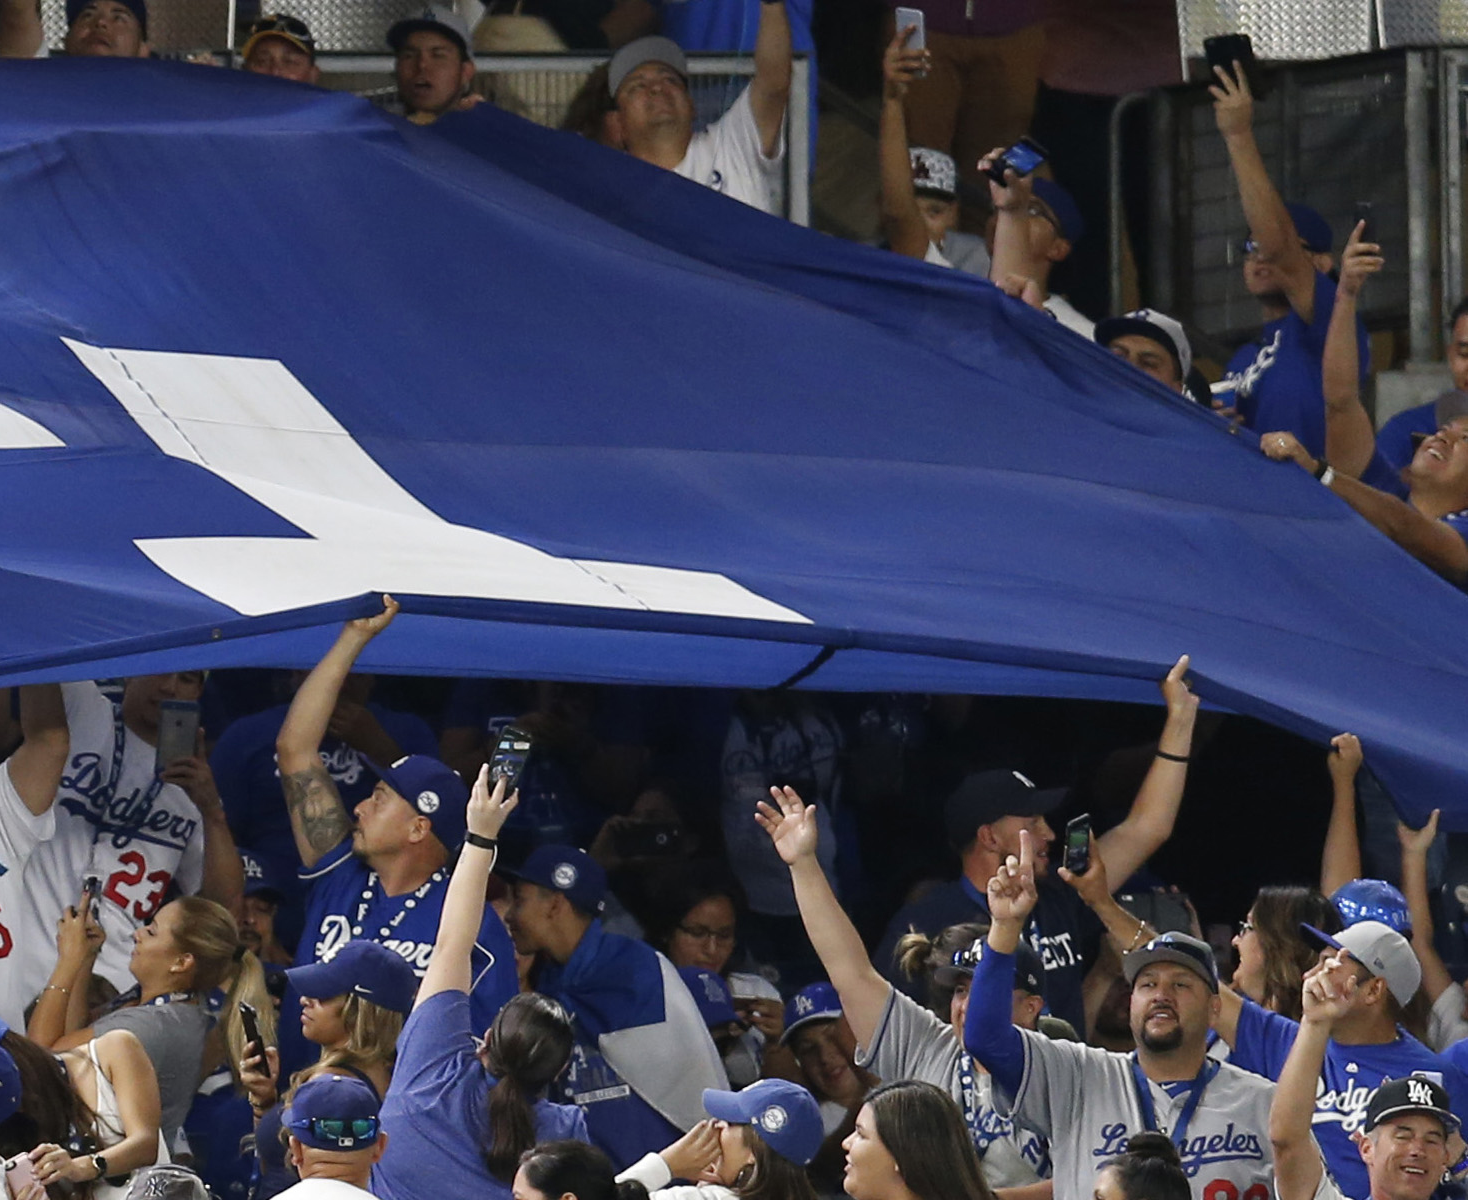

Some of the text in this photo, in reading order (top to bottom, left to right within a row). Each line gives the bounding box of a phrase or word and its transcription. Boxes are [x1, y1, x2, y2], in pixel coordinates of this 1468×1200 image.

[60, 752, 197, 849] Dodgers
[103, 850, 171, 920] 23
[242, 856, 263, 878] LA
[1093, 1123, 1130, 1157] Lo
[1180, 1123, 1262, 1178] ngeles
[145, 1177, 168, 1197] NY
